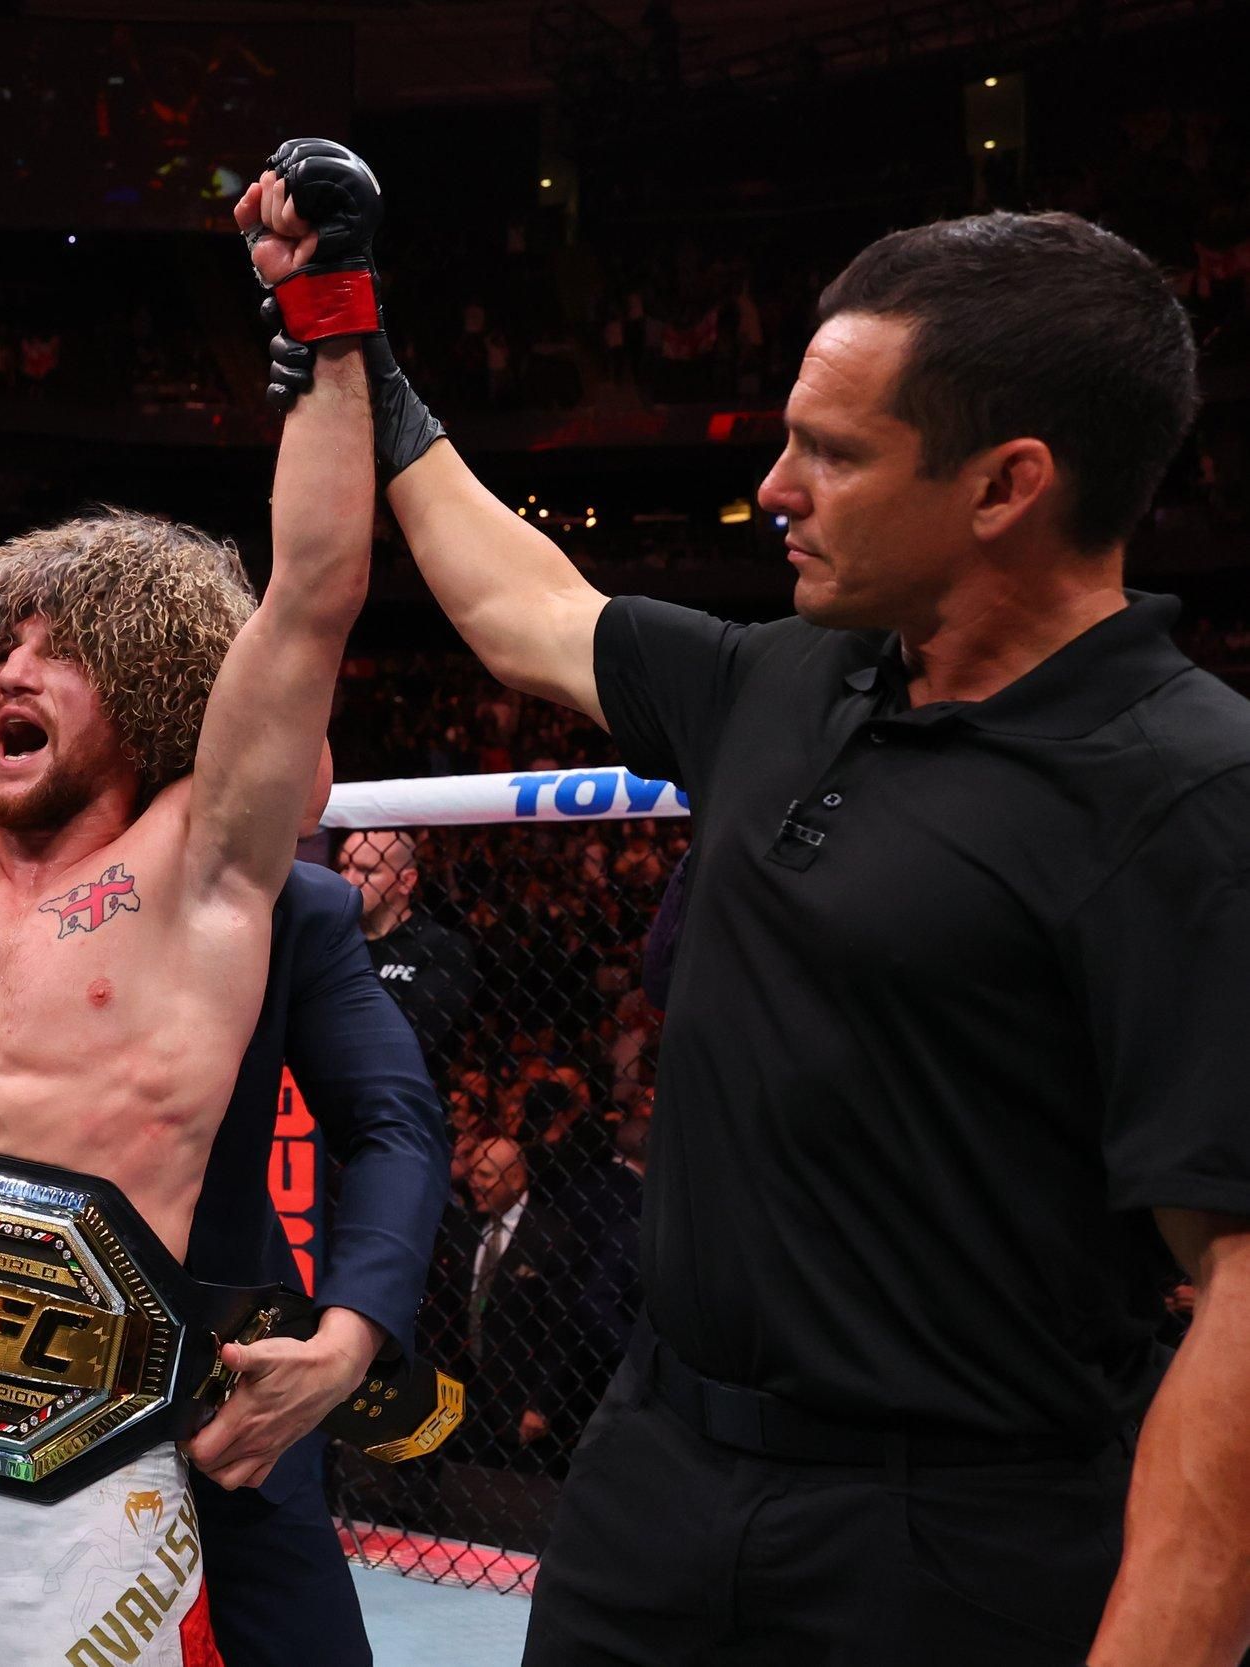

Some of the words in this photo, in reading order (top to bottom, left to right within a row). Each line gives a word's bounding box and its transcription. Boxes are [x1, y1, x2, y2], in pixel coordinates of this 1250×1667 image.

[508, 772, 690, 817] TOY
[379, 964, 417, 982] UFC
[414, 1405, 458, 1450] UFC
